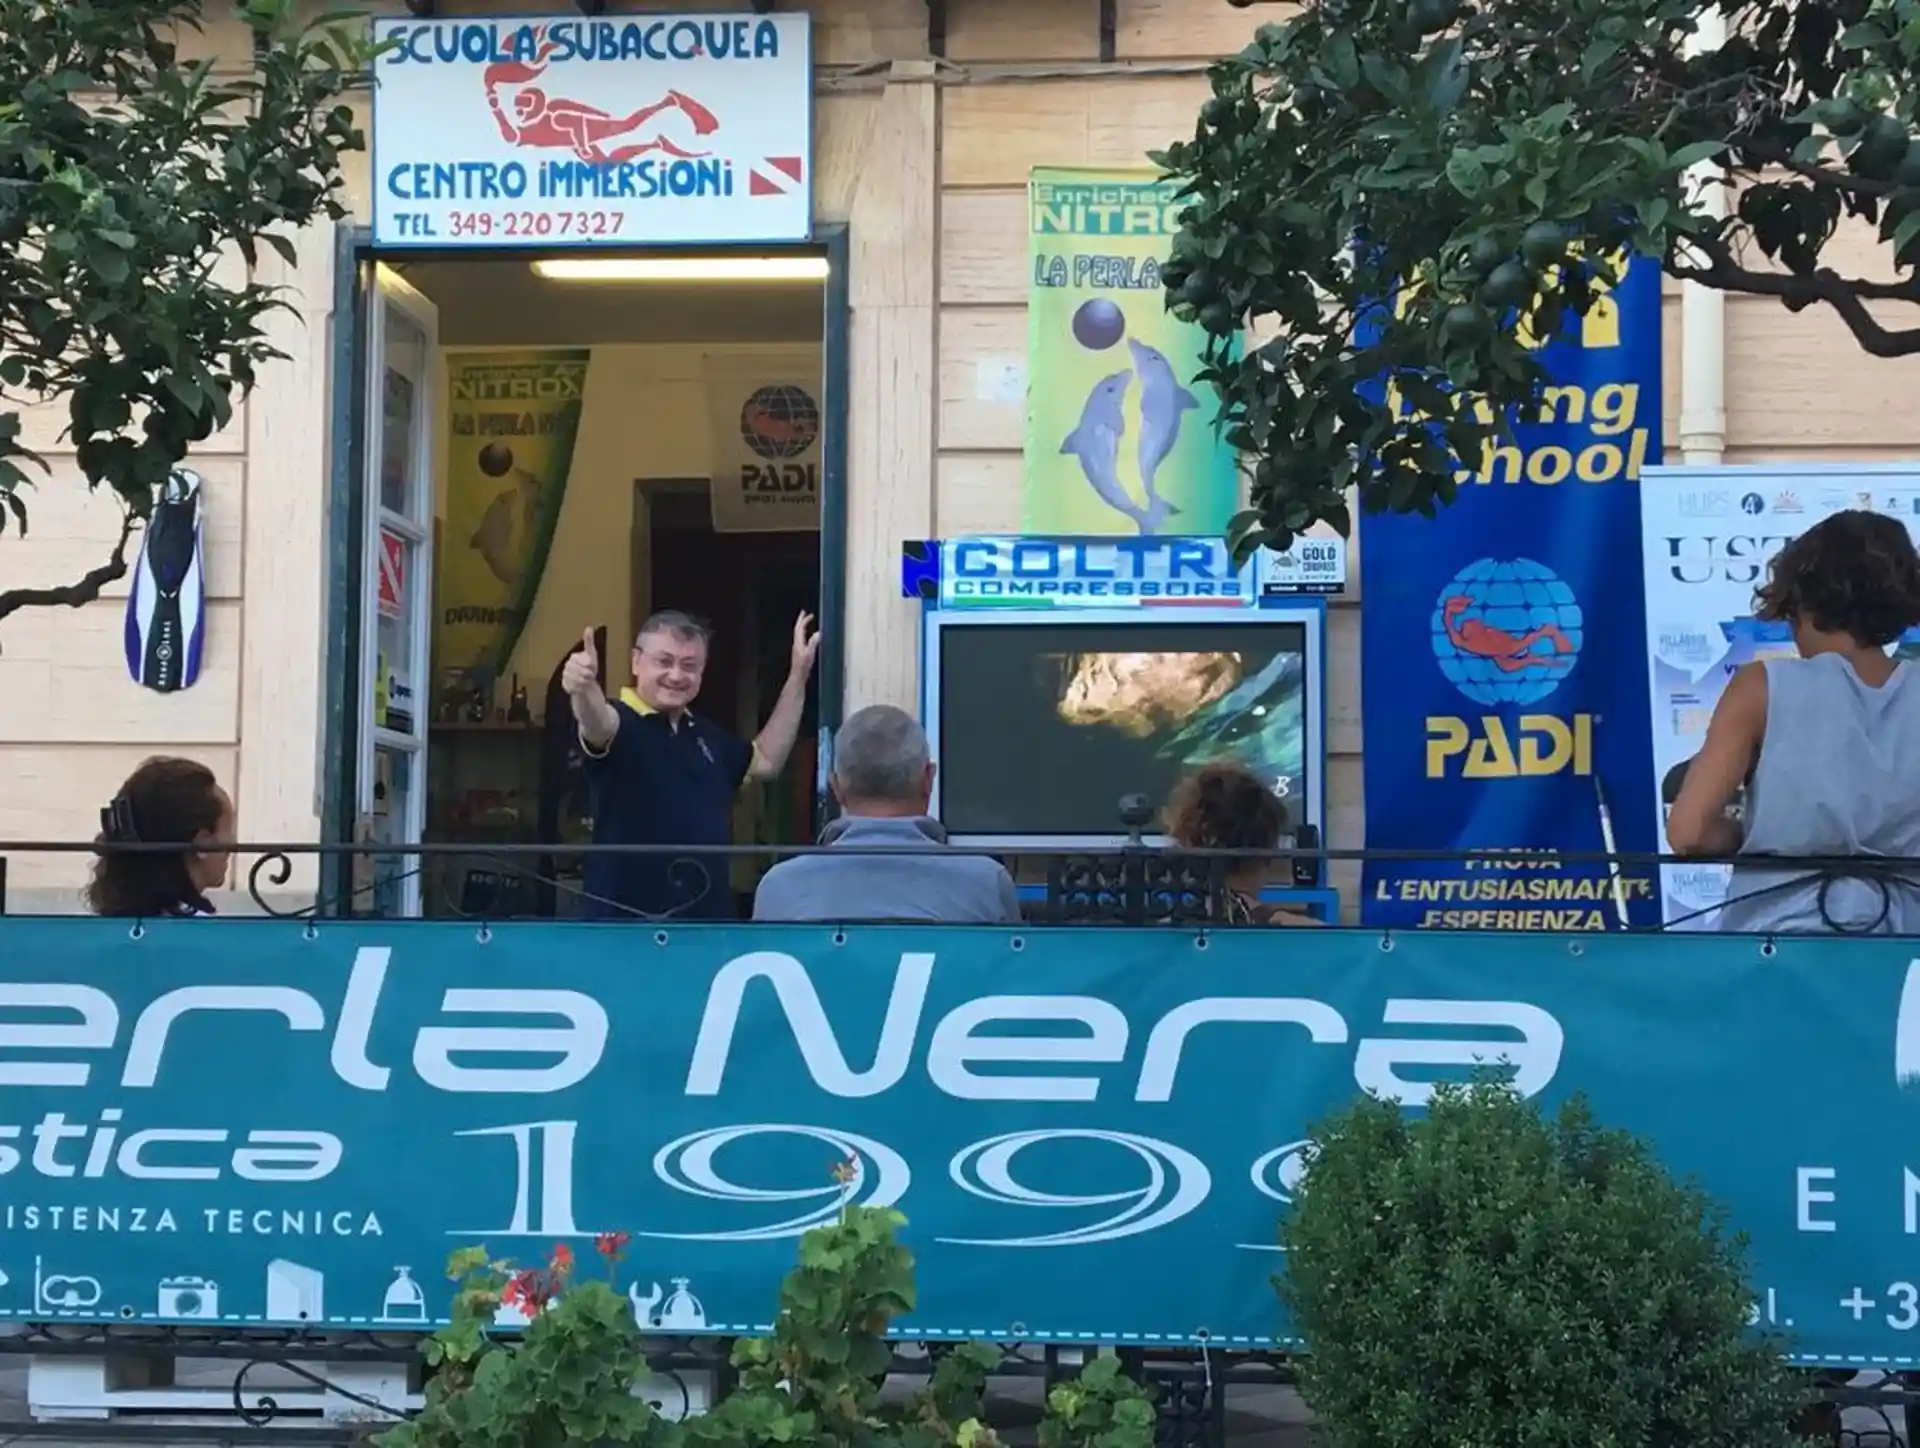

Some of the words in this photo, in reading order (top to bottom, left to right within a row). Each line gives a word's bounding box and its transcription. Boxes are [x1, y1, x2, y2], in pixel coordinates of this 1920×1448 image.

[386, 24, 536, 64] SCUOLA
[549, 20, 778, 62] SUBACQUEA
[388, 162, 527, 199] CENTRO
[393, 212, 437, 236] TEL
[1035, 253, 1067, 287] LA
[1073, 255, 1161, 289] PERLA
[451, 377, 580, 399] NITROX
[741, 464, 816, 492] PADI
[953, 541, 1246, 578] COLTRI
[1302, 546, 1336, 561] GOLD
[953, 581, 1240, 597] COMPRESSORS
[1426, 714, 1592, 778] PADI
[1420, 910, 1606, 930] ESPERIENZA
[684, 950, 1564, 1107] Nera
[0, 1108, 343, 1181] tica
[445, 1119, 1319, 1251] 199
[204, 1209, 384, 1236] TECNICA
